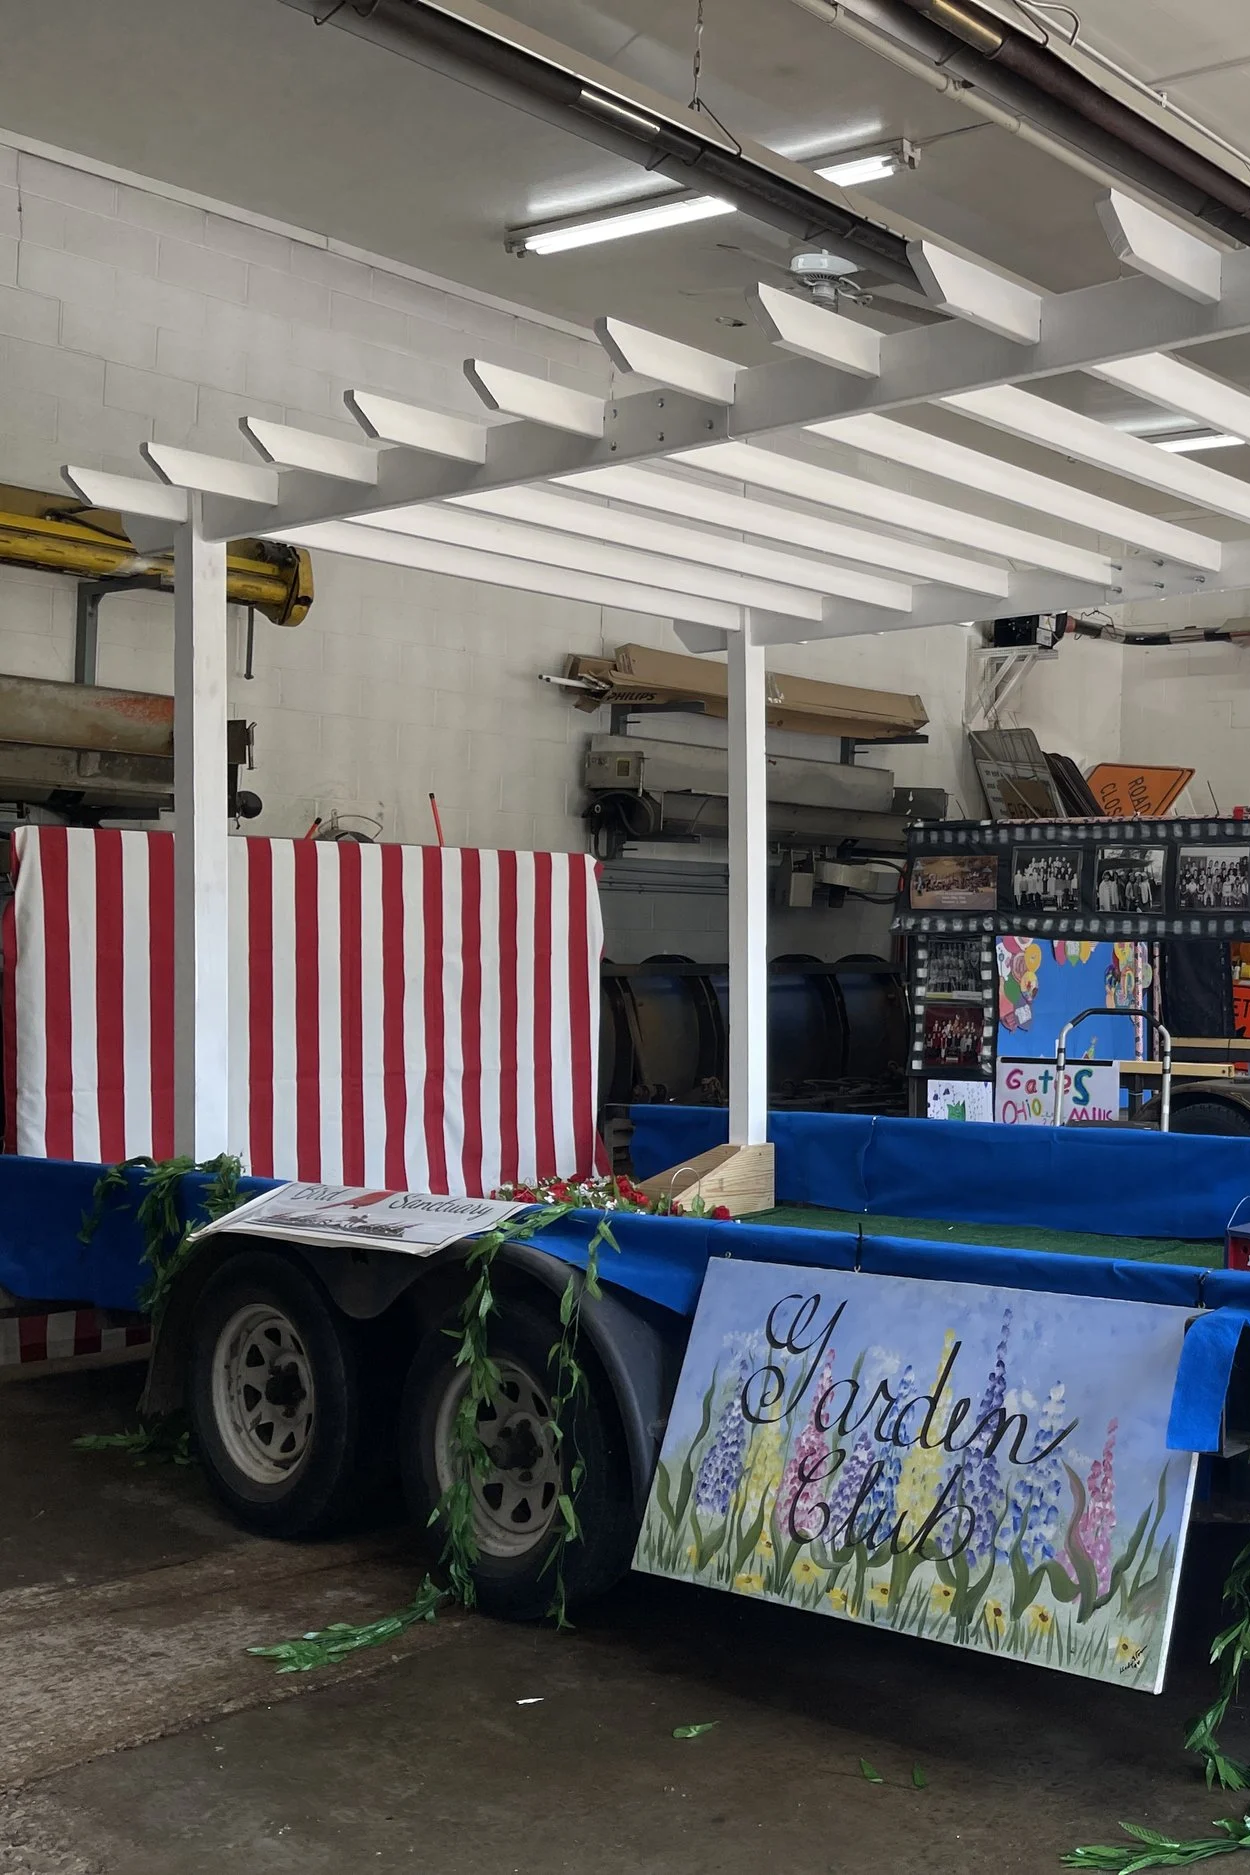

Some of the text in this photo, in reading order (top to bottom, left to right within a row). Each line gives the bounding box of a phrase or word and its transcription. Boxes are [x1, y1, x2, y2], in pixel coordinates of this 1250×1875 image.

[1100, 782, 1124, 816] CLOS
[290, 1184, 493, 1221] Bird Sanctuary
[741, 1293, 1080, 1465] Garden
[786, 1448, 977, 1562] Club
